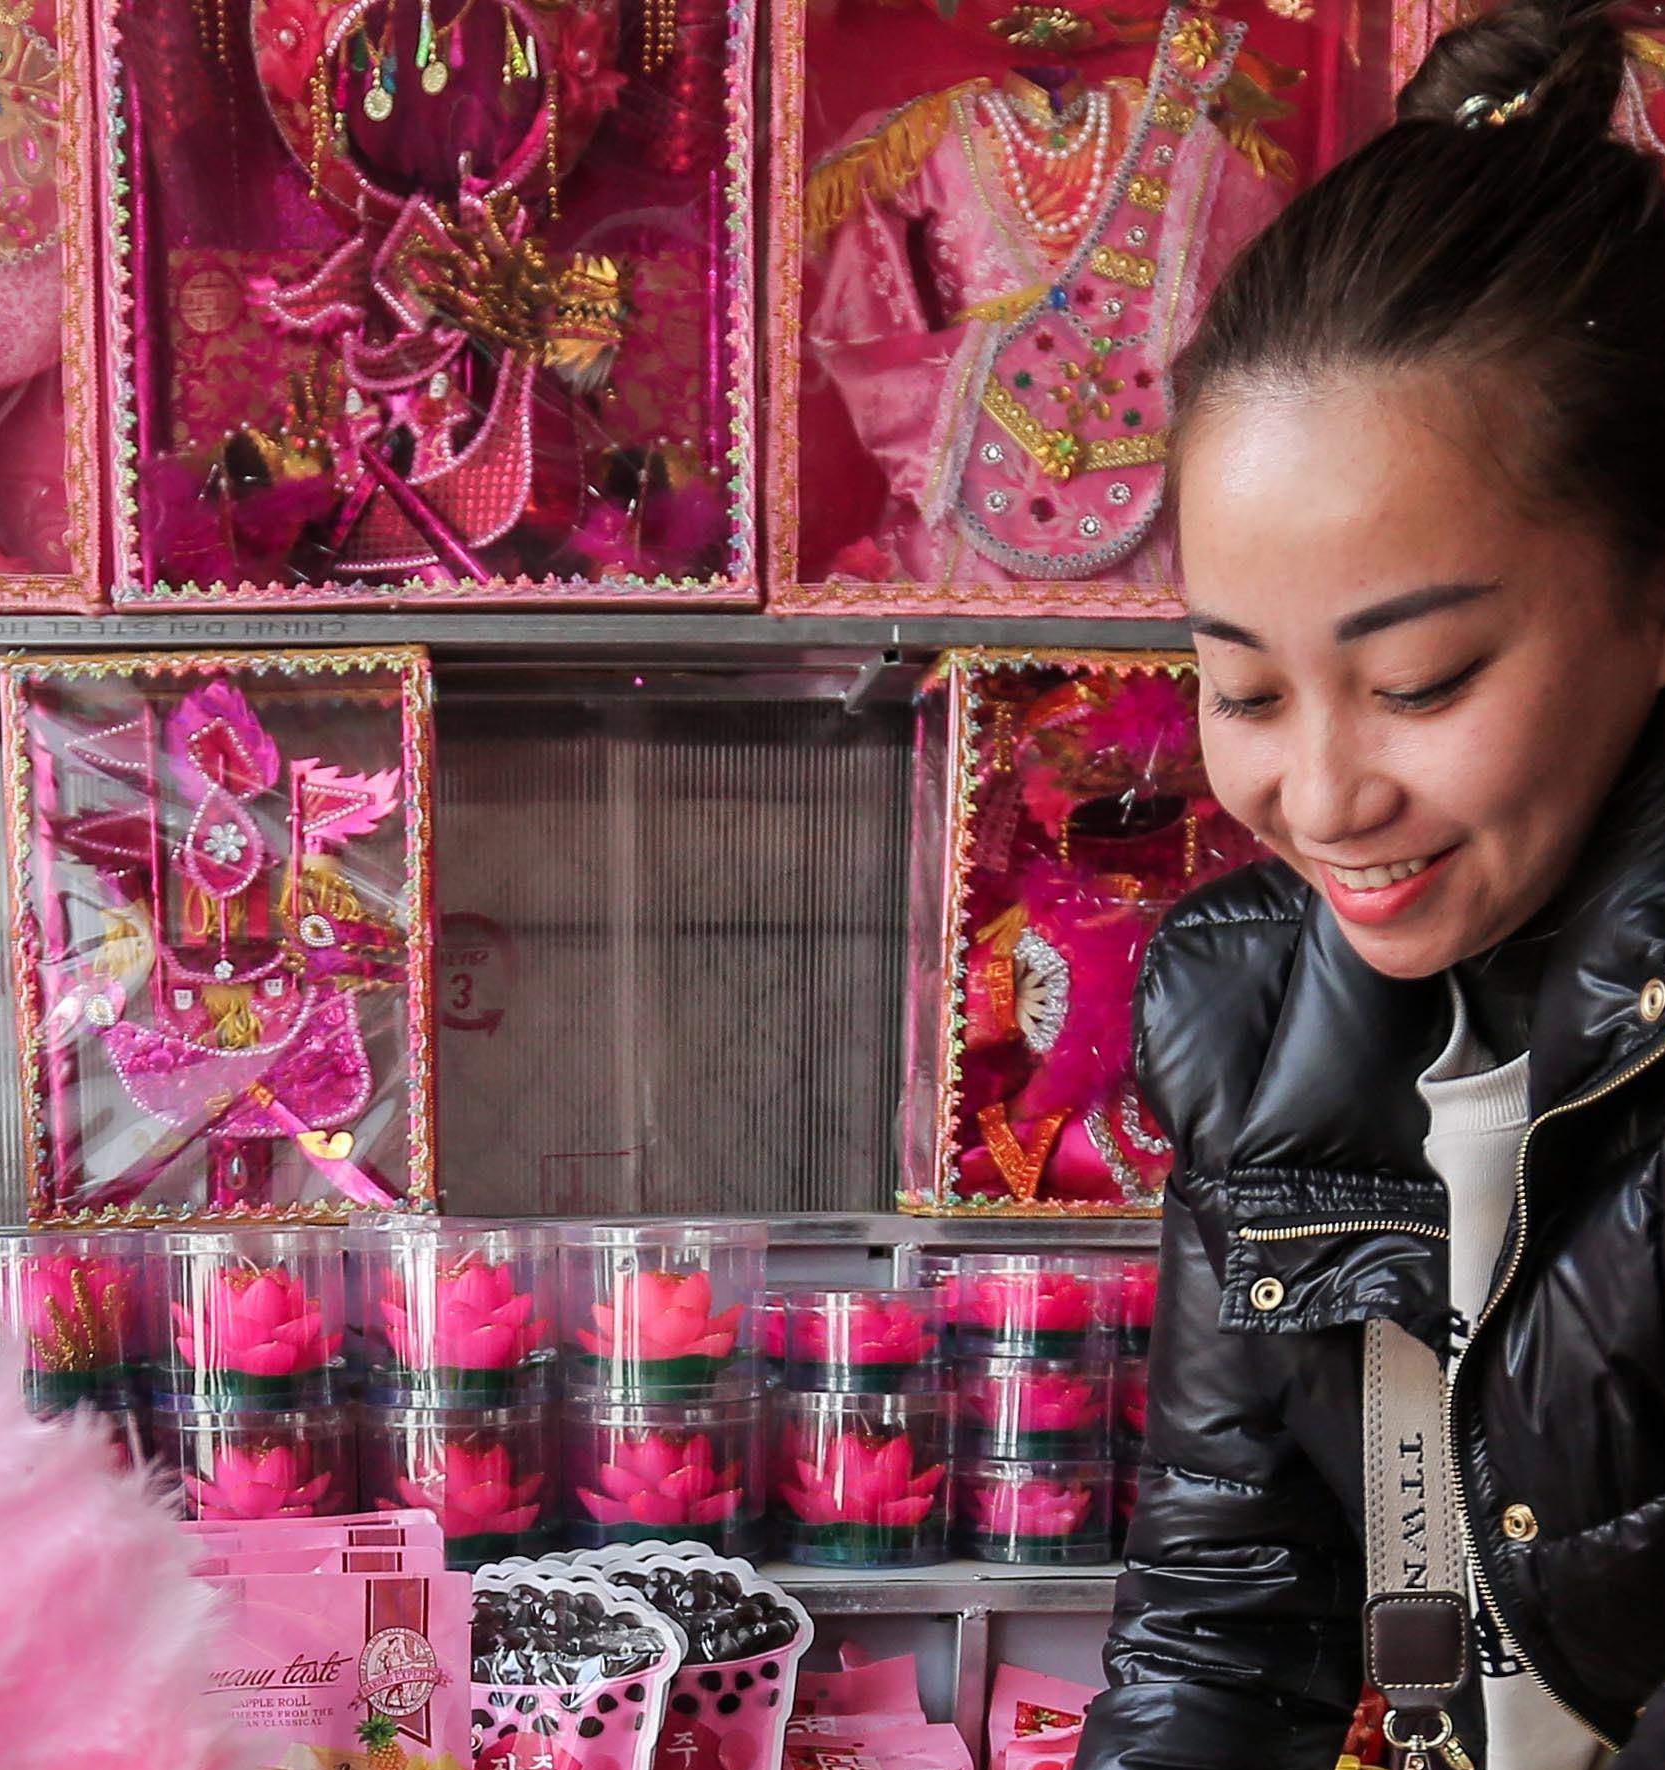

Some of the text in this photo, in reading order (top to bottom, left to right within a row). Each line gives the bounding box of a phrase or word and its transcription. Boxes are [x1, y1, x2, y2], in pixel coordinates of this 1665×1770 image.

[44, 621, 154, 637] STEEL
[285, 1651, 353, 1685] taste
[278, 1695, 311, 1708] ROLL
[278, 1709, 308, 1719] FROM
[666, 1731, 699, 1768] 주
